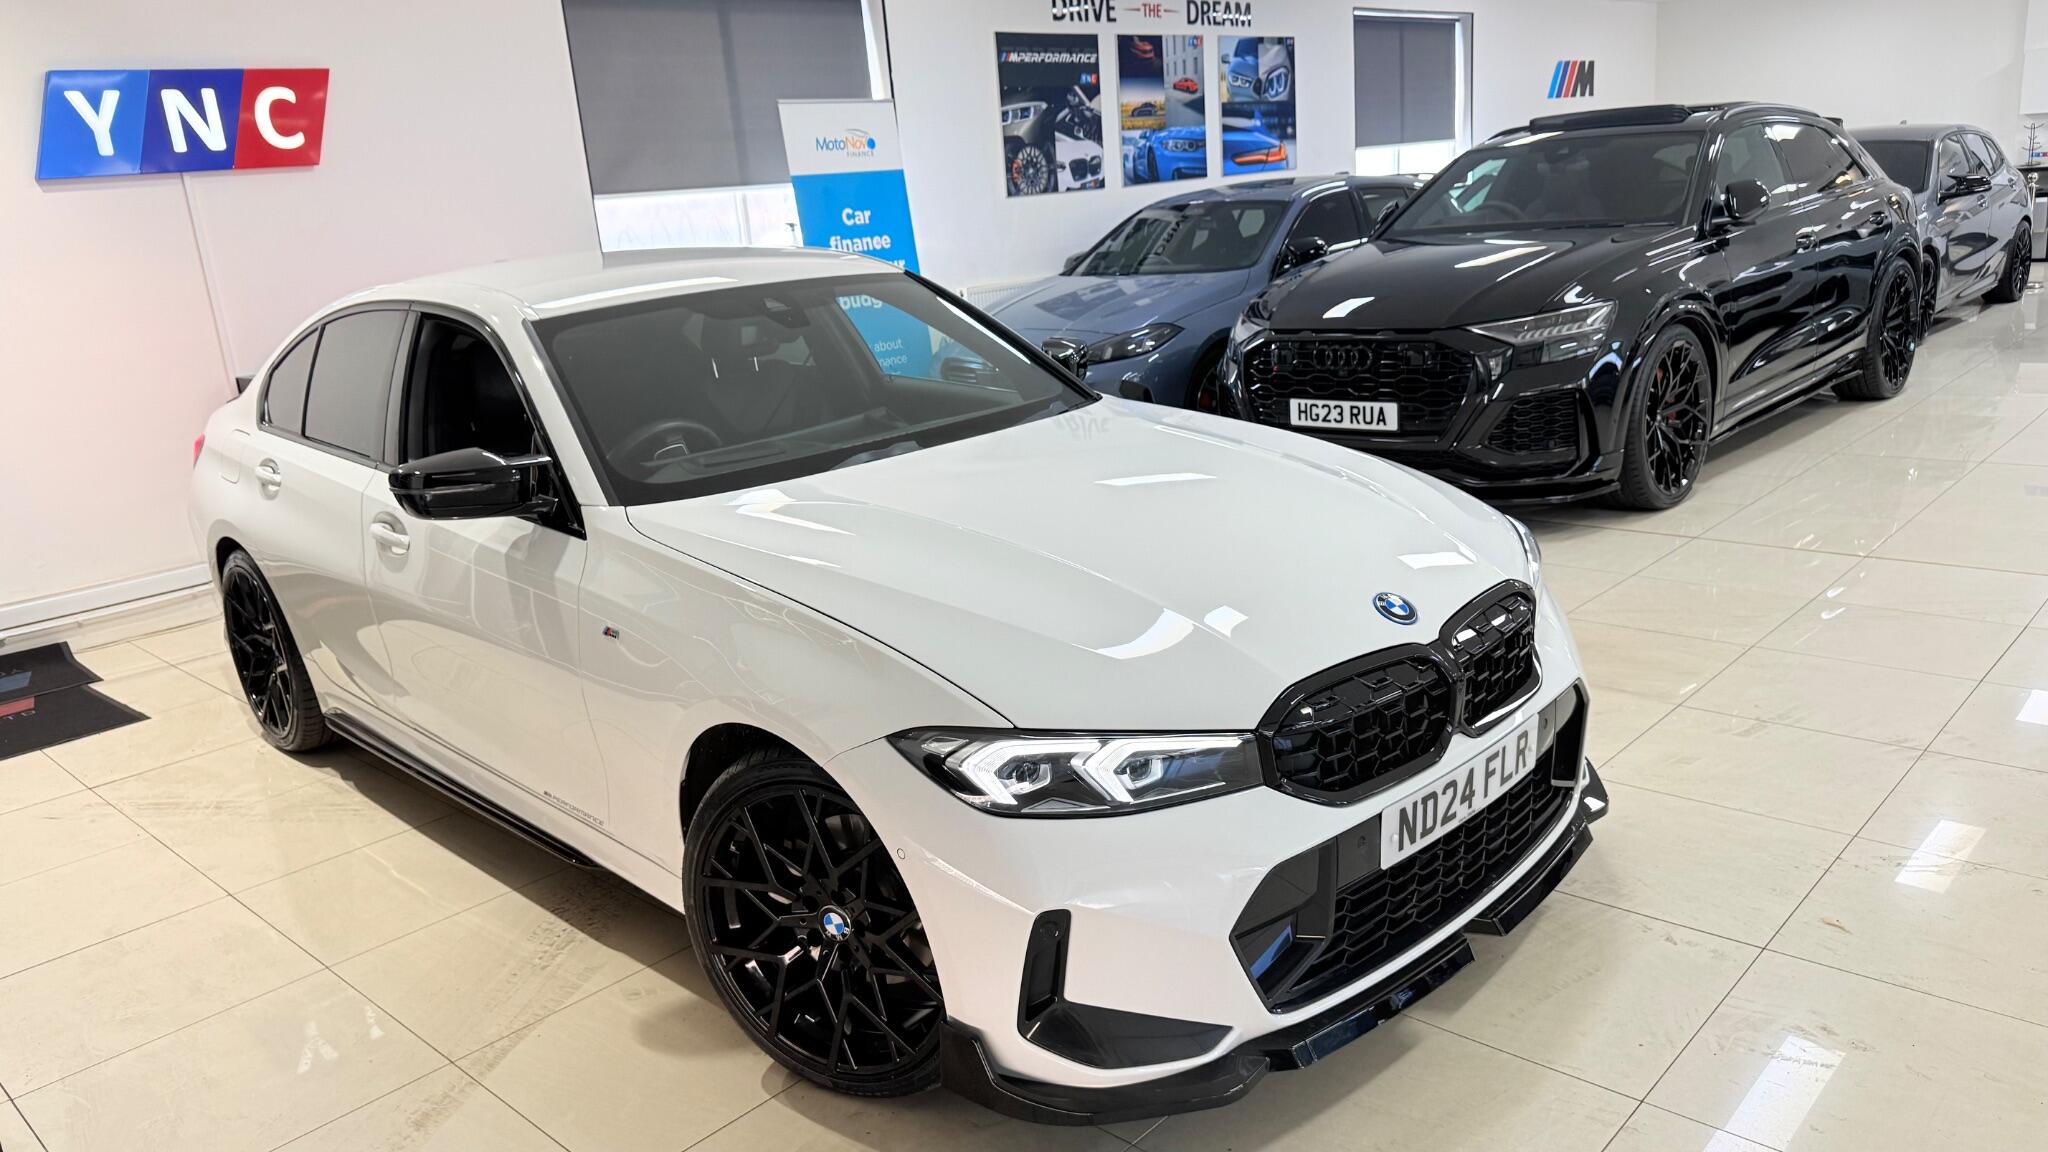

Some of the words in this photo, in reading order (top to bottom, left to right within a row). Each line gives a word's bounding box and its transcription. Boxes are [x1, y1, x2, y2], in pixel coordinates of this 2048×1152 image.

[1052, 0, 1117, 23] DRIVE
[1142, 3, 1163, 19] THE
[1187, 0, 1251, 27] DREAM
[64, 85, 306, 157] YNC
[842, 207, 872, 226] Car
[829, 234, 892, 252] finance
[874, 339, 904, 352] about
[879, 355, 908, 367] nance
[1297, 402, 1344, 424] HG23
[1350, 405, 1387, 426] RUA
[1398, 767, 1476, 852] ND24
[1483, 730, 1529, 799] FLR
